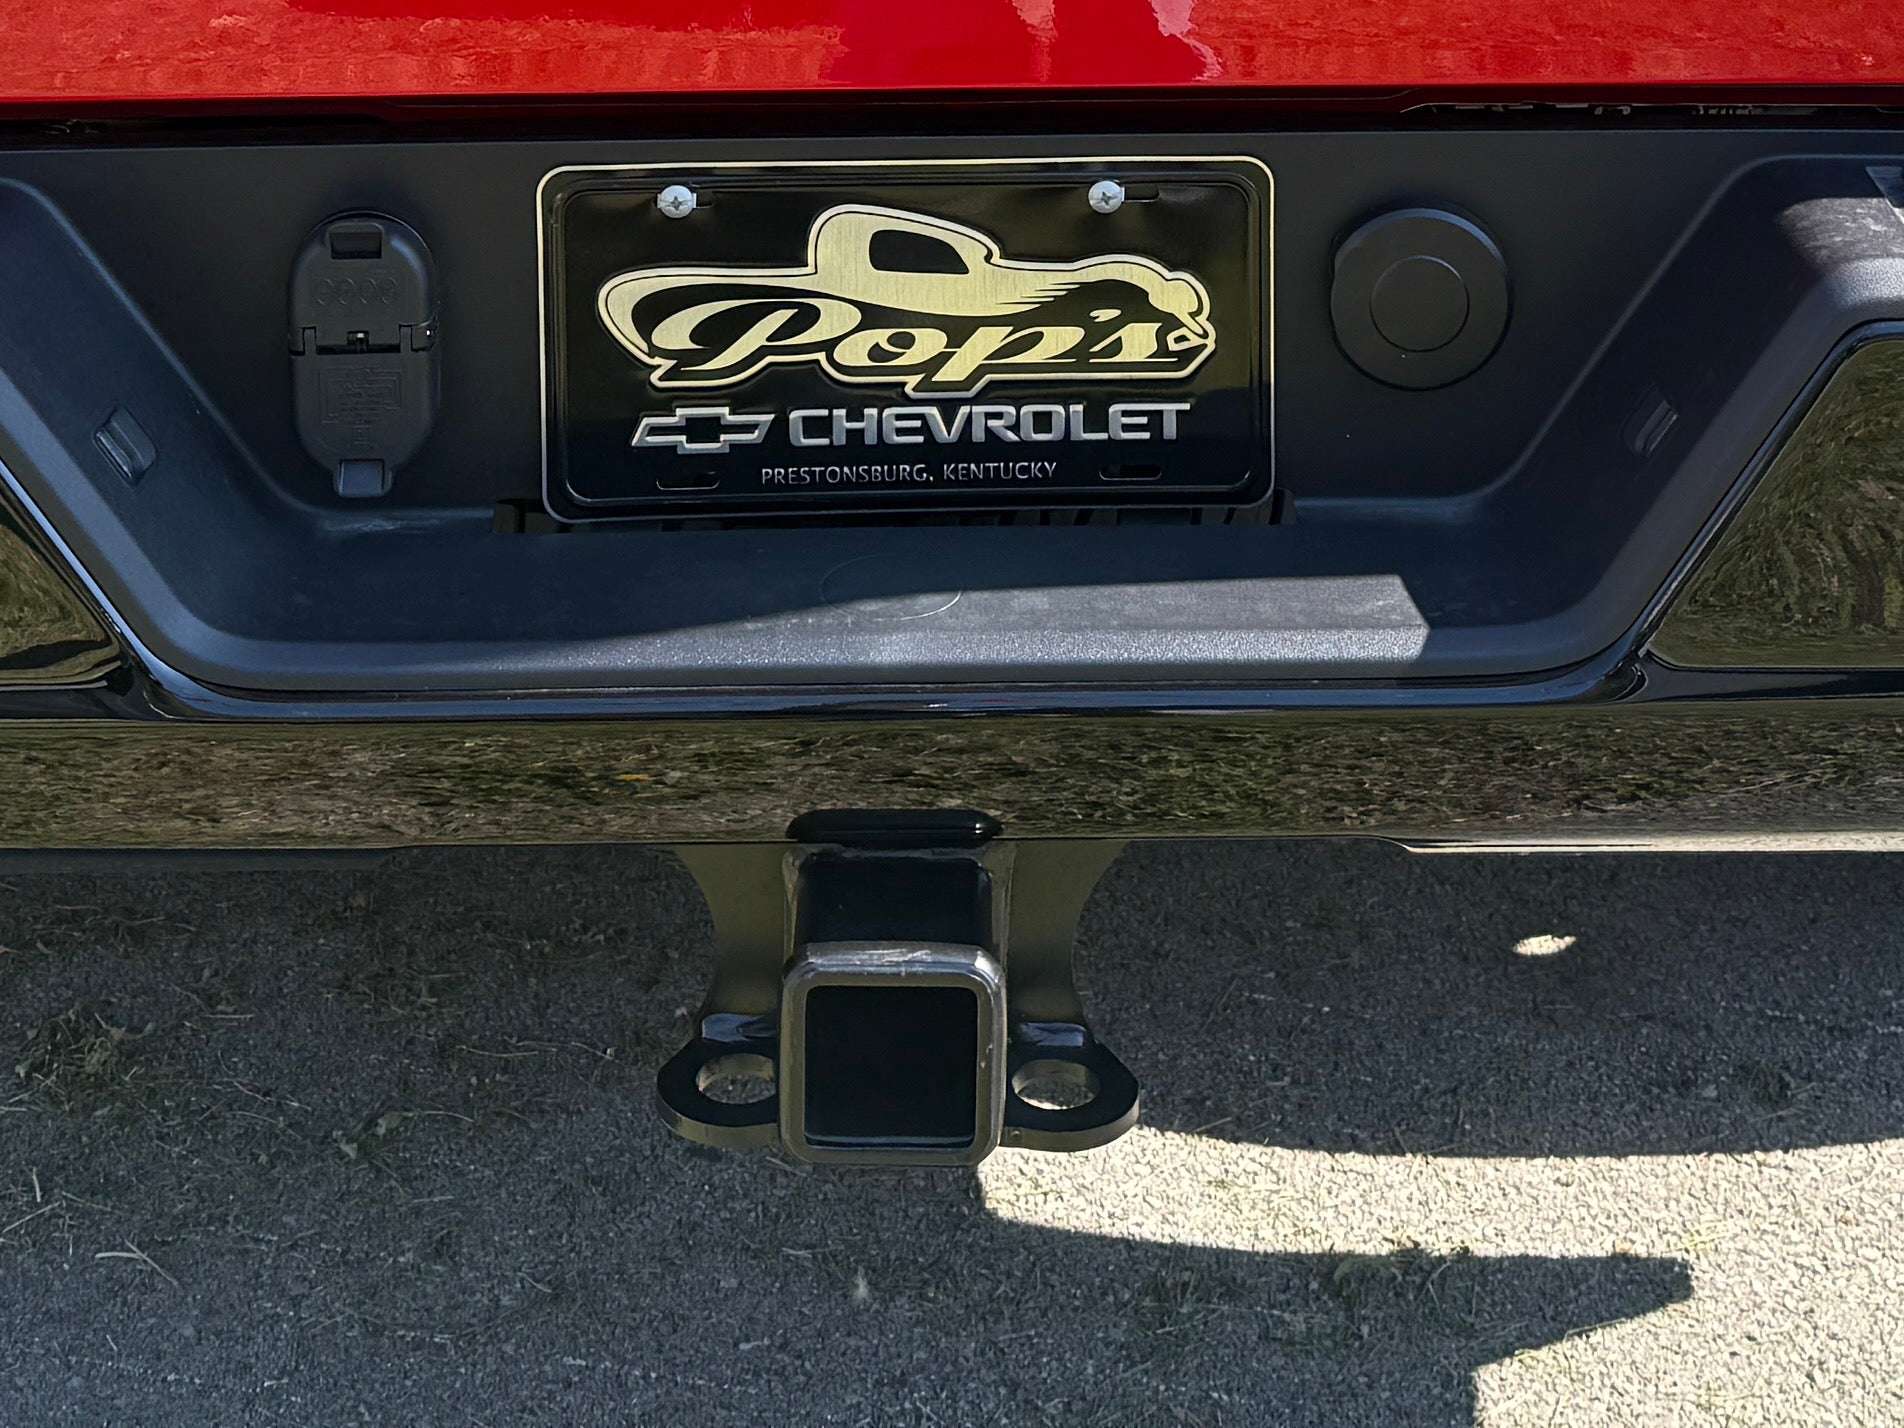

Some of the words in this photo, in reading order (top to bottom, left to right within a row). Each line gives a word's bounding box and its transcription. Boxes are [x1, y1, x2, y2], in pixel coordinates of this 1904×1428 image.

[651, 296, 1176, 383] Pop's
[788, 401, 1192, 446] CHEVROLET
[760, 463, 935, 486] PRESTONSBURG,
[943, 461, 1057, 482] KENTUCKY
